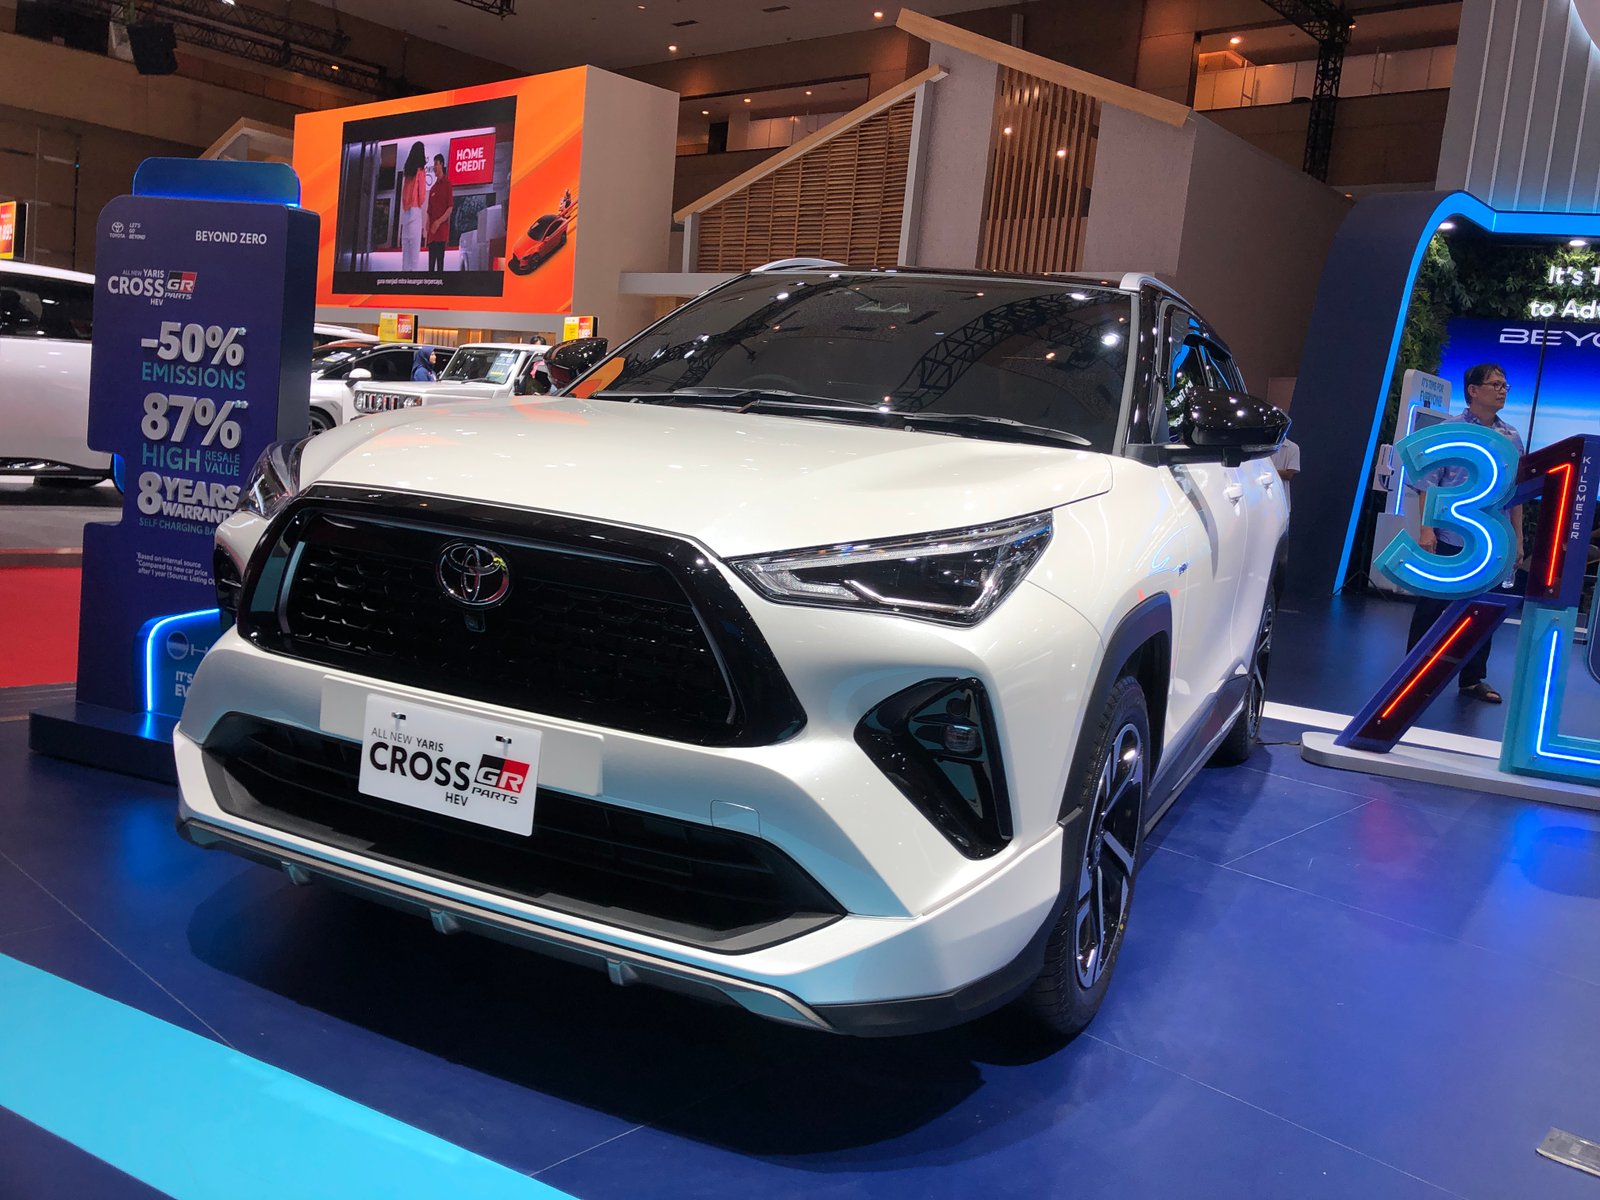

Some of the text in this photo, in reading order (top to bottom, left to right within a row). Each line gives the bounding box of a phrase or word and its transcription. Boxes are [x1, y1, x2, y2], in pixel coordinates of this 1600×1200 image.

[456, 147, 484, 160] HOME
[455, 159, 486, 173] CREDIT
[195, 230, 267, 245] BEYOND ZERO
[143, 268, 165, 279] YARIS
[1548, 265, 1584, 286] It's
[107, 275, 164, 298] CROSS
[166, 278, 194, 292] GR
[150, 298, 164, 306] HEV
[164, 292, 192, 300] PARTS
[1531, 299, 1600, 319] to Ad
[1499, 328, 1600, 348] BEY
[141, 361, 246, 390] EMISSIONS
[142, 442, 200, 473] HIGH
[205, 450, 240, 464] RESALE
[205, 461, 240, 476] VALUE
[137, 471, 241, 515] 8 YEARS
[1570, 456, 1592, 540] KILOMETER
[139, 517, 157, 528] SELF
[159, 519, 203, 535] CHARGING
[162, 556, 182, 566] internal
[184, 560, 201, 569] source
[138, 567, 150, 575] after
[155, 570, 166, 578] year
[189, 575, 207, 586] Listing
[185, 567, 194, 575] car
[194, 569, 208, 578] price
[175, 670, 193, 684] IT'S
[371, 727, 444, 753] ALL NEW YARIS
[370, 741, 471, 791] CROSS
[476, 765, 523, 793] GR
[445, 791, 468, 807] HEV
[471, 786, 519, 805] PARTS
